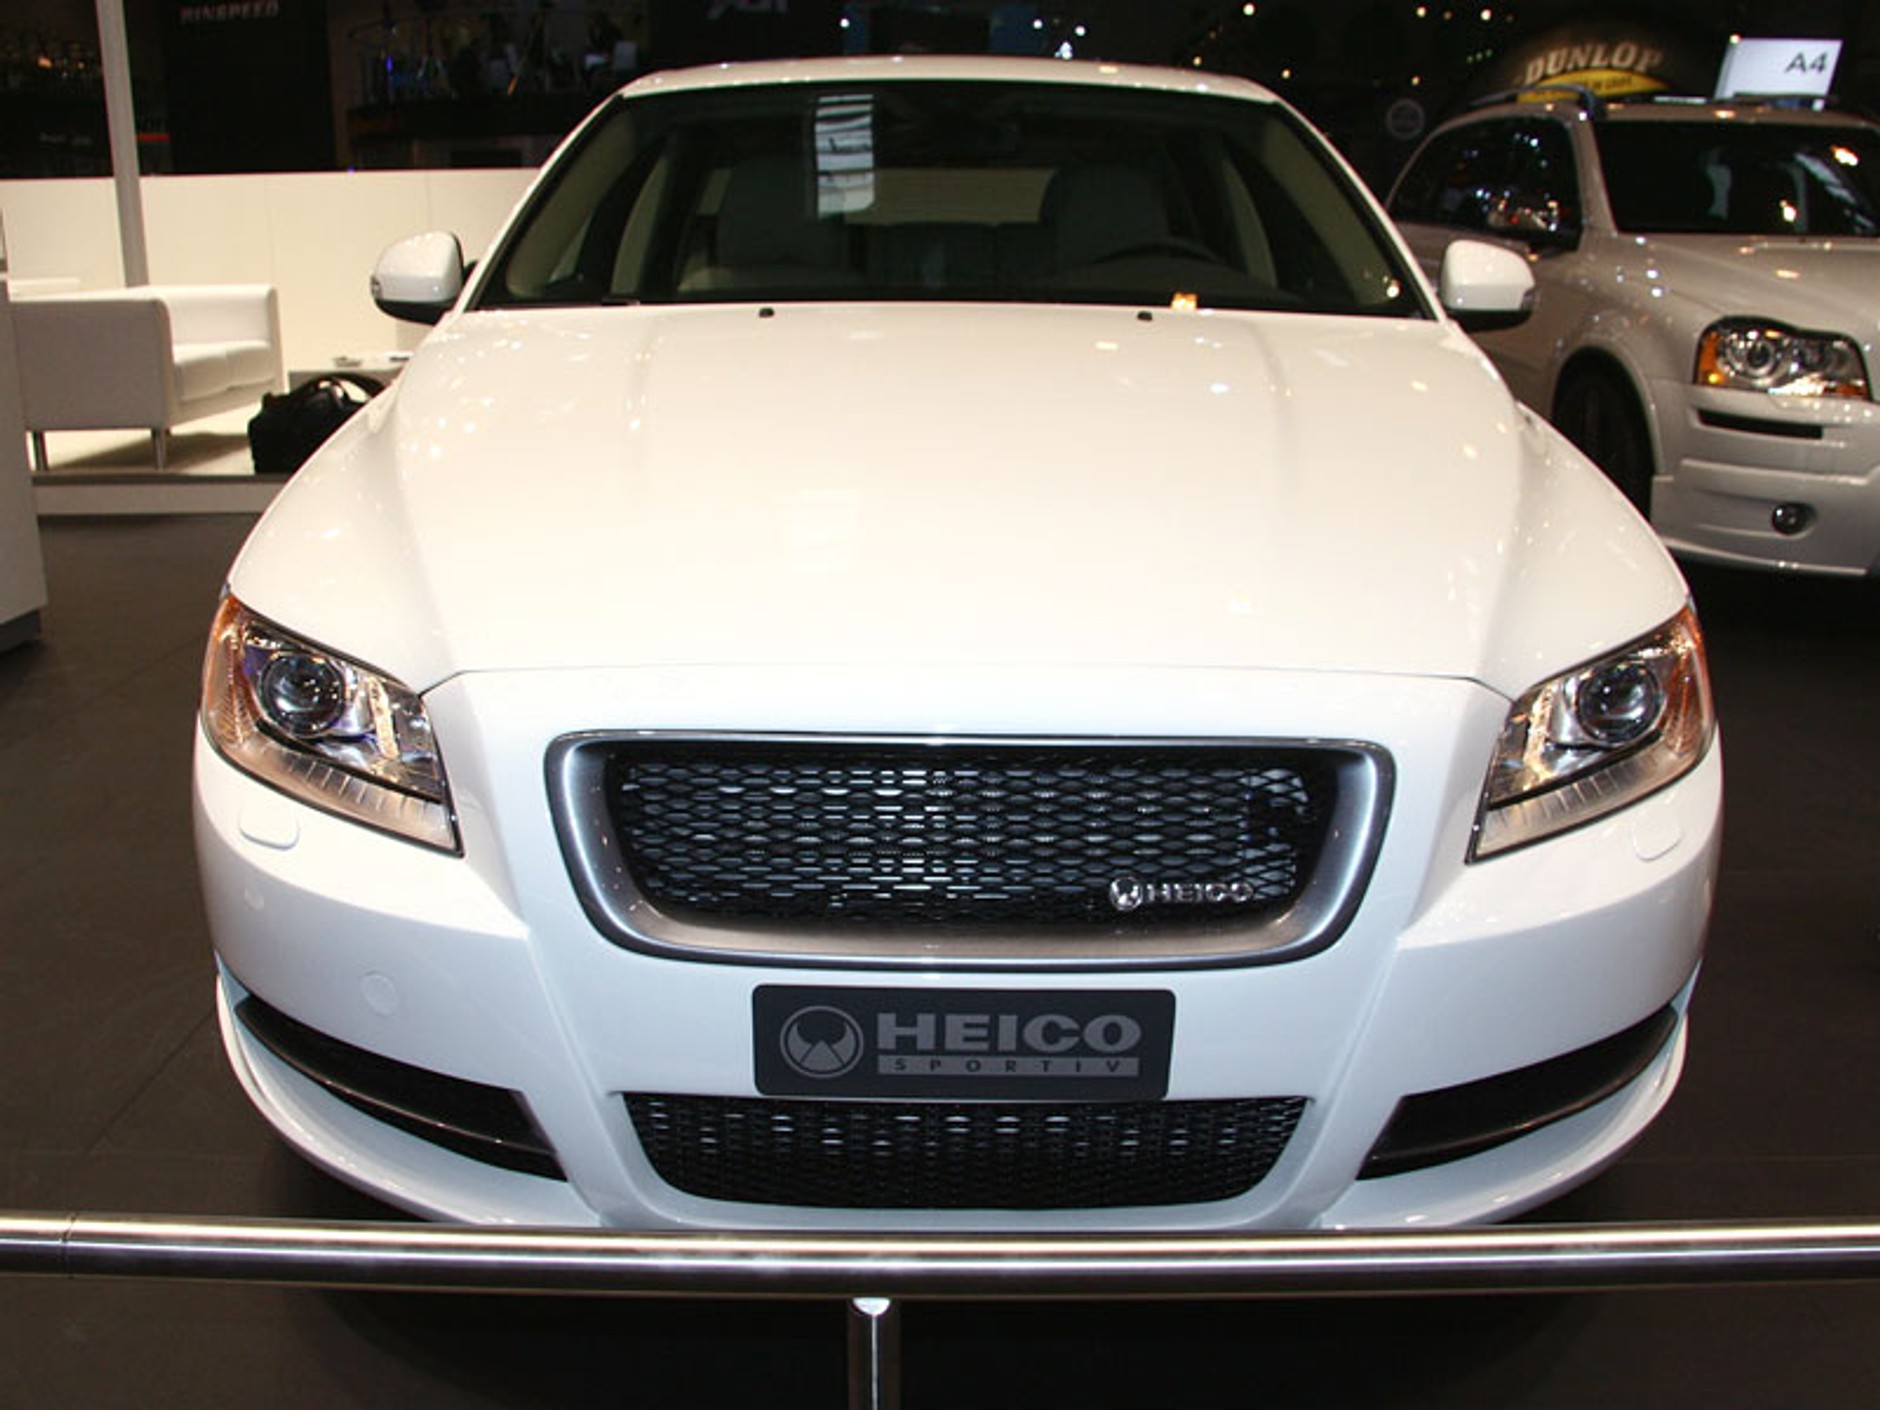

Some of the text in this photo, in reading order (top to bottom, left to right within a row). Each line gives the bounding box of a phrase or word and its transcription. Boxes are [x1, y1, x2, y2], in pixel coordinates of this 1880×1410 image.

[1524, 41, 1664, 84] DUNLOP
[1785, 52, 1829, 74] A4
[1146, 882, 1254, 902] HEICO
[876, 1012, 1142, 1054] HEICO
[894, 1057, 1121, 1074] SPORTIV
